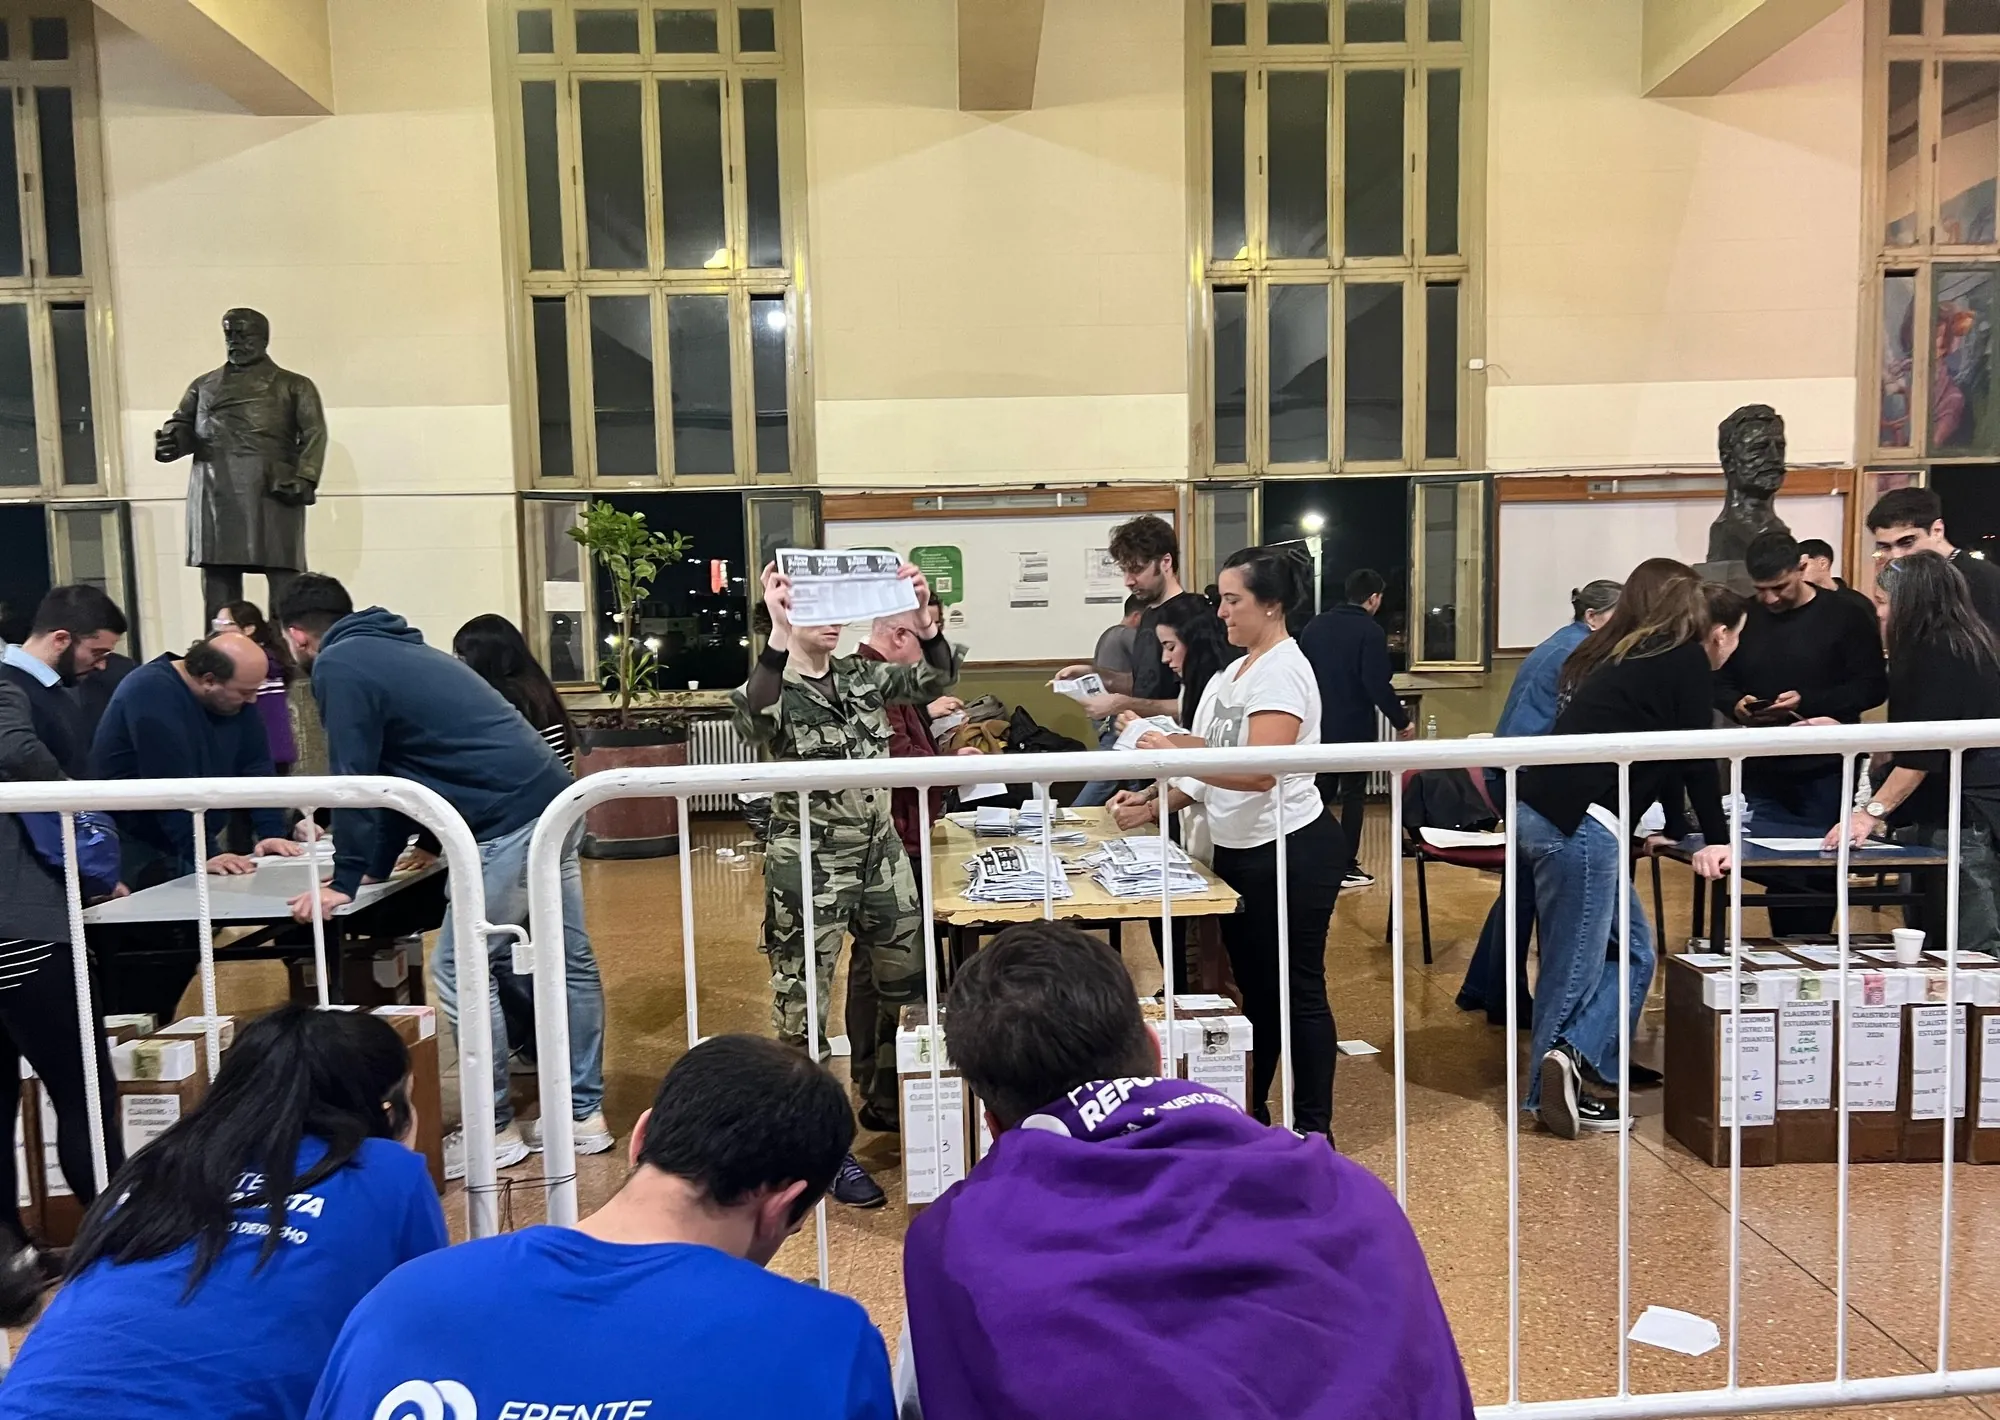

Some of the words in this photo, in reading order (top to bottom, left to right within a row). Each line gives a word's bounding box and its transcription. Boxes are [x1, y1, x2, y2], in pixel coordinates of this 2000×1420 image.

[1751, 1069, 1761, 1081] 2
[1806, 1074, 1815, 1083] 3
[1752, 1091, 1763, 1101] 5
[942, 1139, 951, 1153] 3
[943, 1163, 955, 1177] 2
